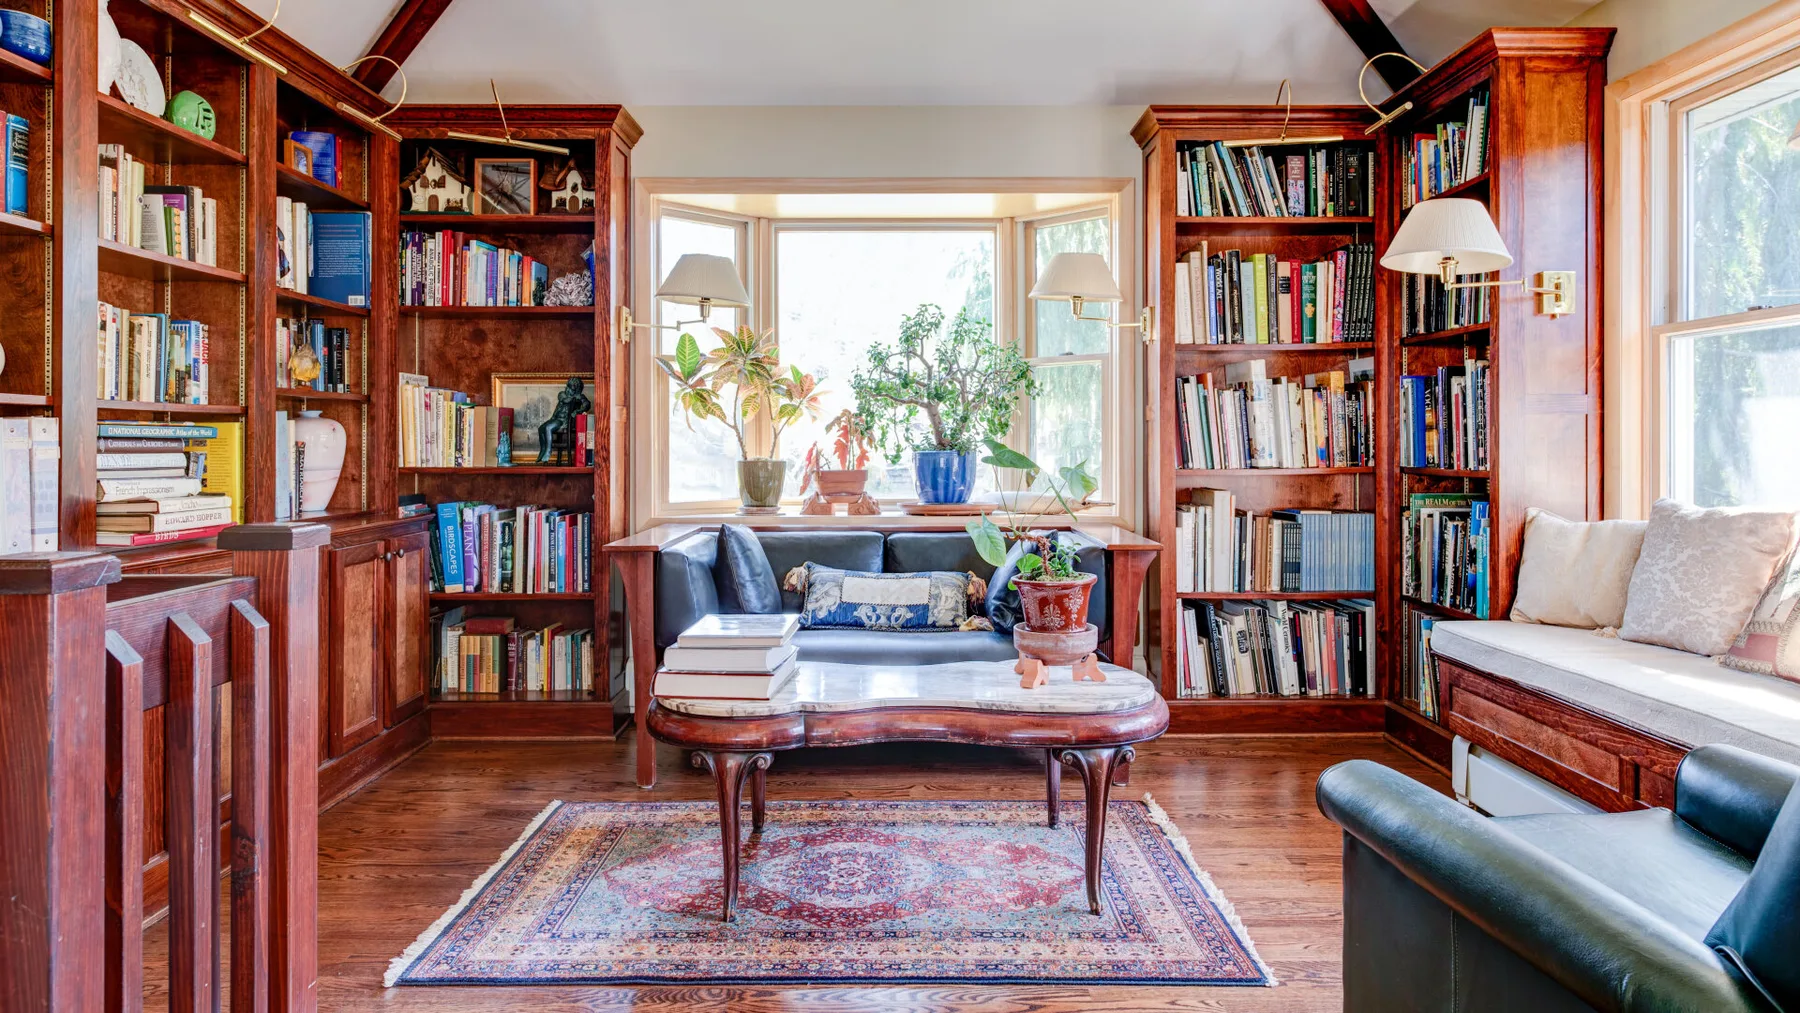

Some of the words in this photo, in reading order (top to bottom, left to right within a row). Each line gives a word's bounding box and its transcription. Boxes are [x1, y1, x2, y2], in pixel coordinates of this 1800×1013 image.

[115, 486, 136, 495] French
[137, 486, 174, 496] Impressionism
[165, 515, 195, 524] EDWARD
[196, 512, 222, 521] HOPPER
[155, 531, 178, 540] BIRDS
[464, 524, 473, 556] PLANT
[447, 525, 458, 574] BIRDSCAPES
[1283, 626, 1291, 653] Ceramics
